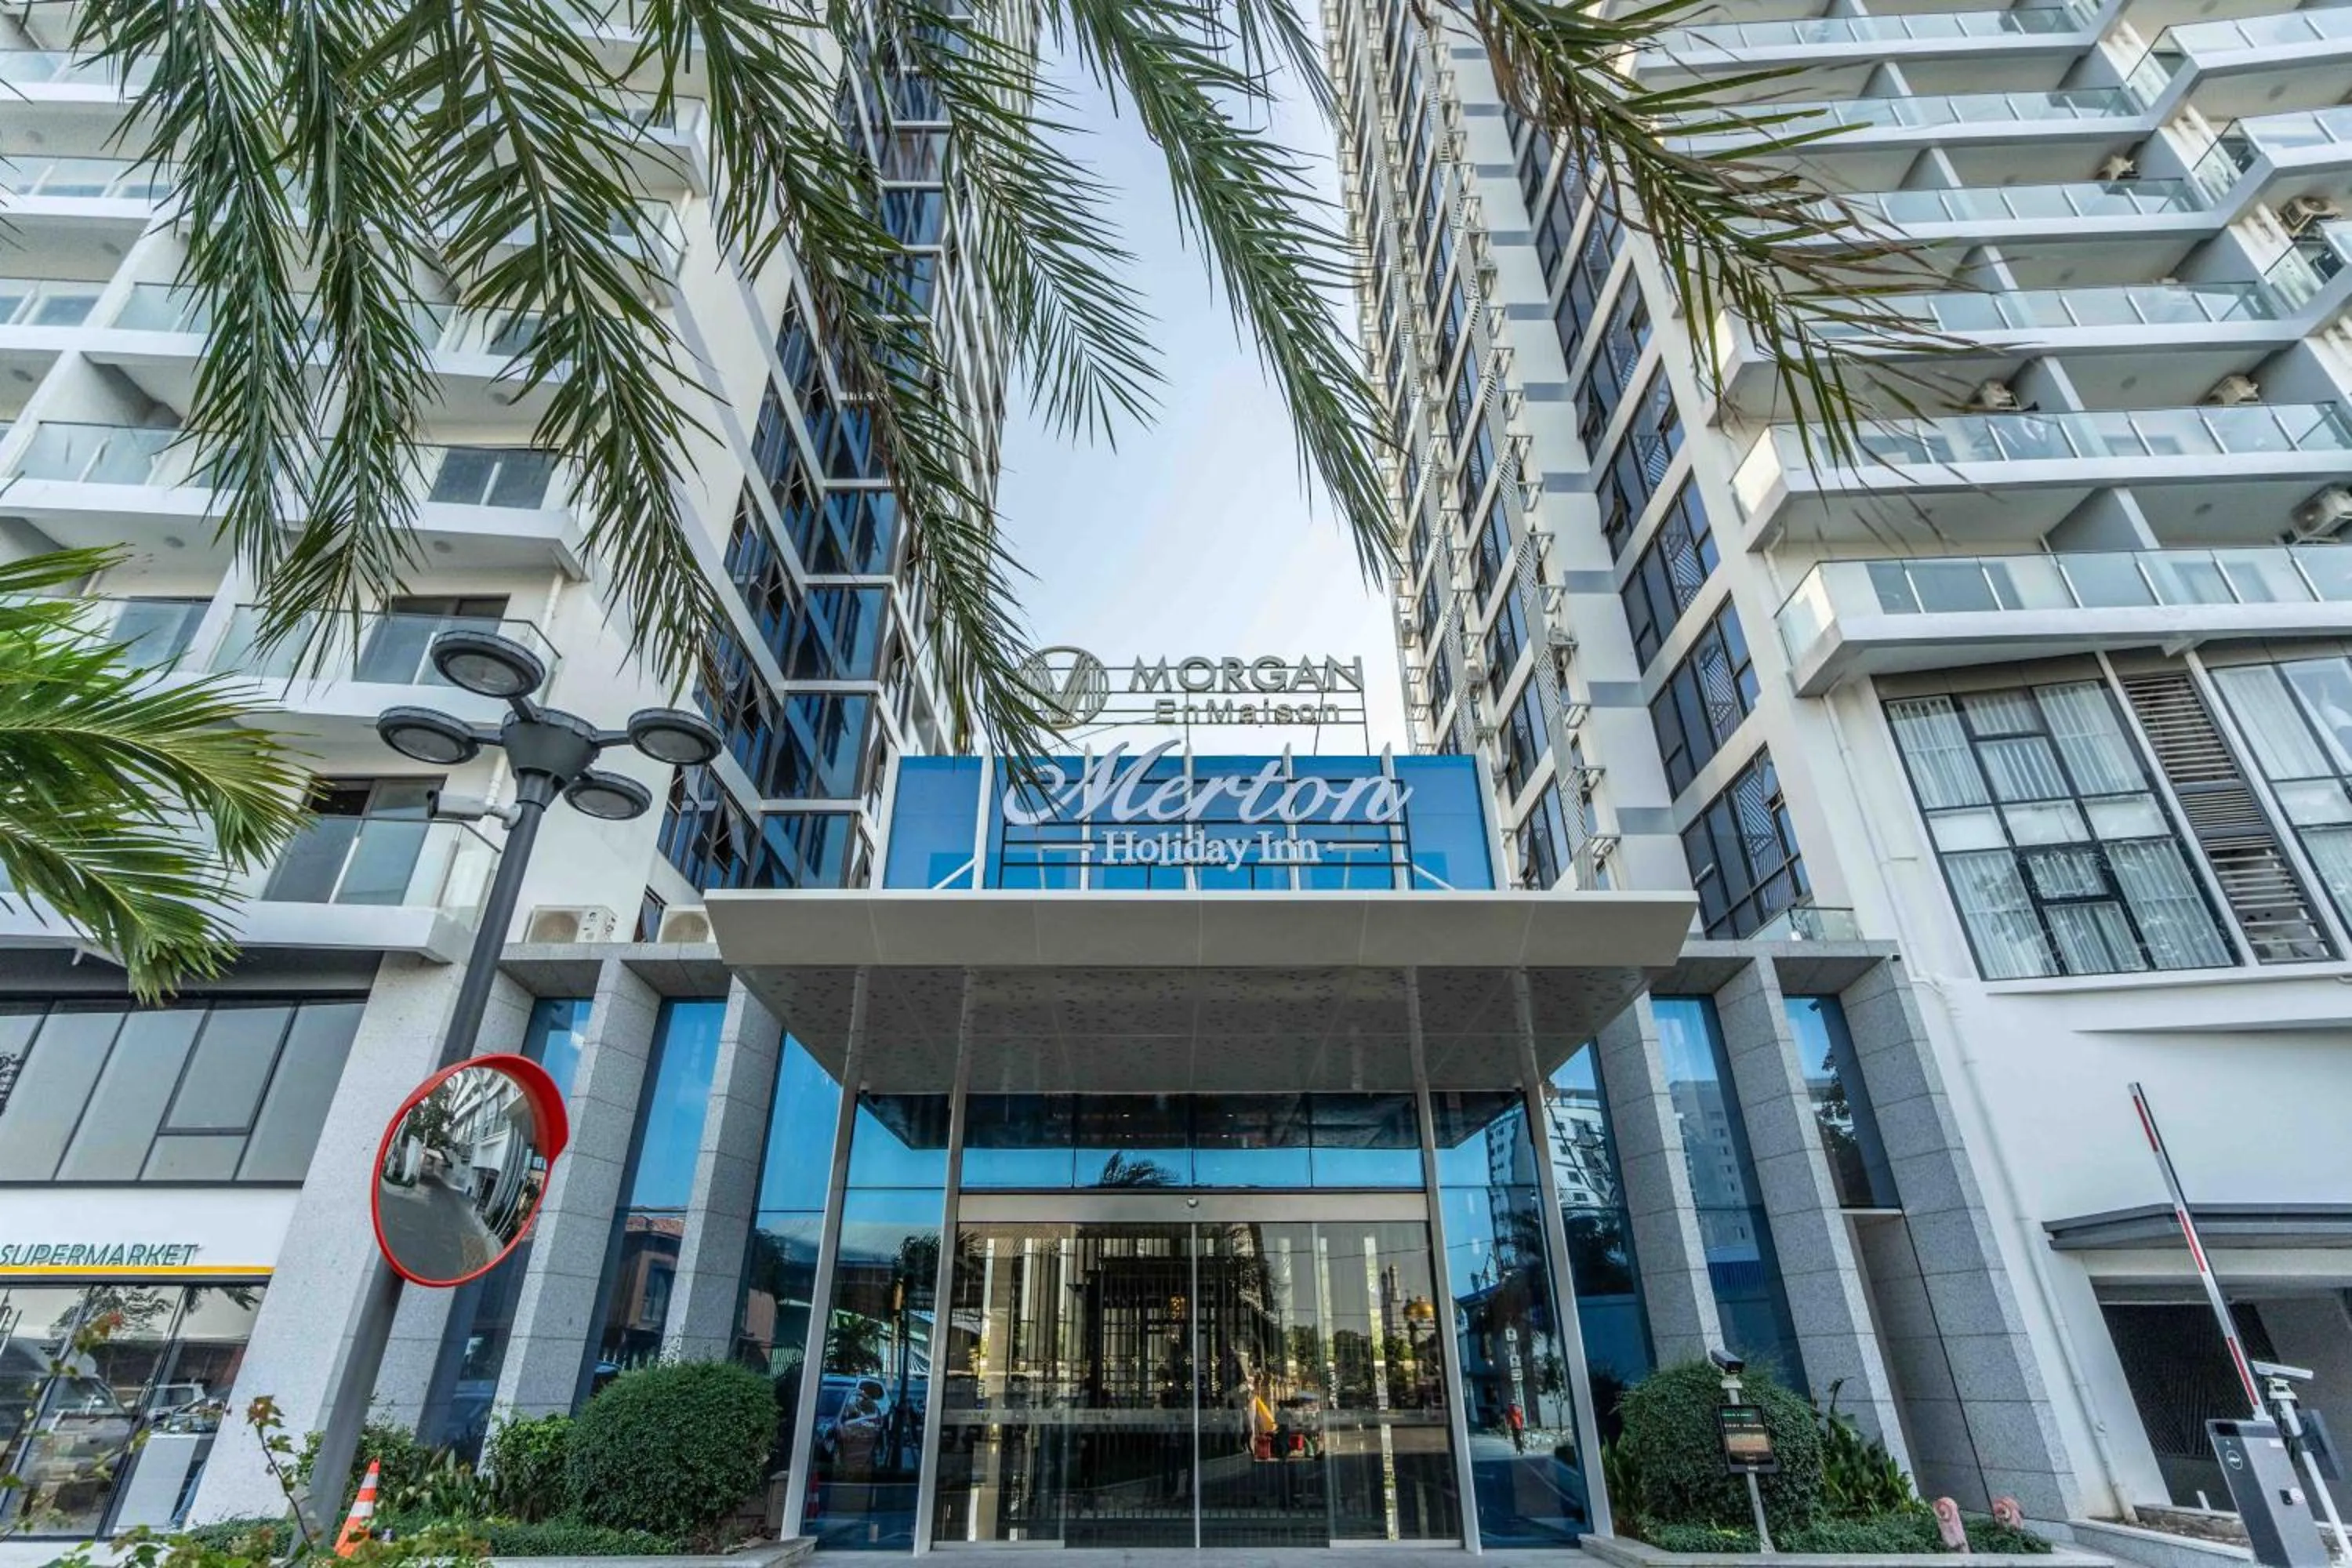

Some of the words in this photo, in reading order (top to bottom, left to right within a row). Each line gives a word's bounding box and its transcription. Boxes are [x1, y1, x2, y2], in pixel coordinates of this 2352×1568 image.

[1129, 653, 1363, 692] MORGAN
[1155, 698, 1340, 724] EnMaison
[1003, 739, 1414, 824] Merton
[1102, 829, 1250, 871] Holiday
[1256, 830, 1323, 864] Inn
[0, 1243, 201, 1266] SUPERMARKET
